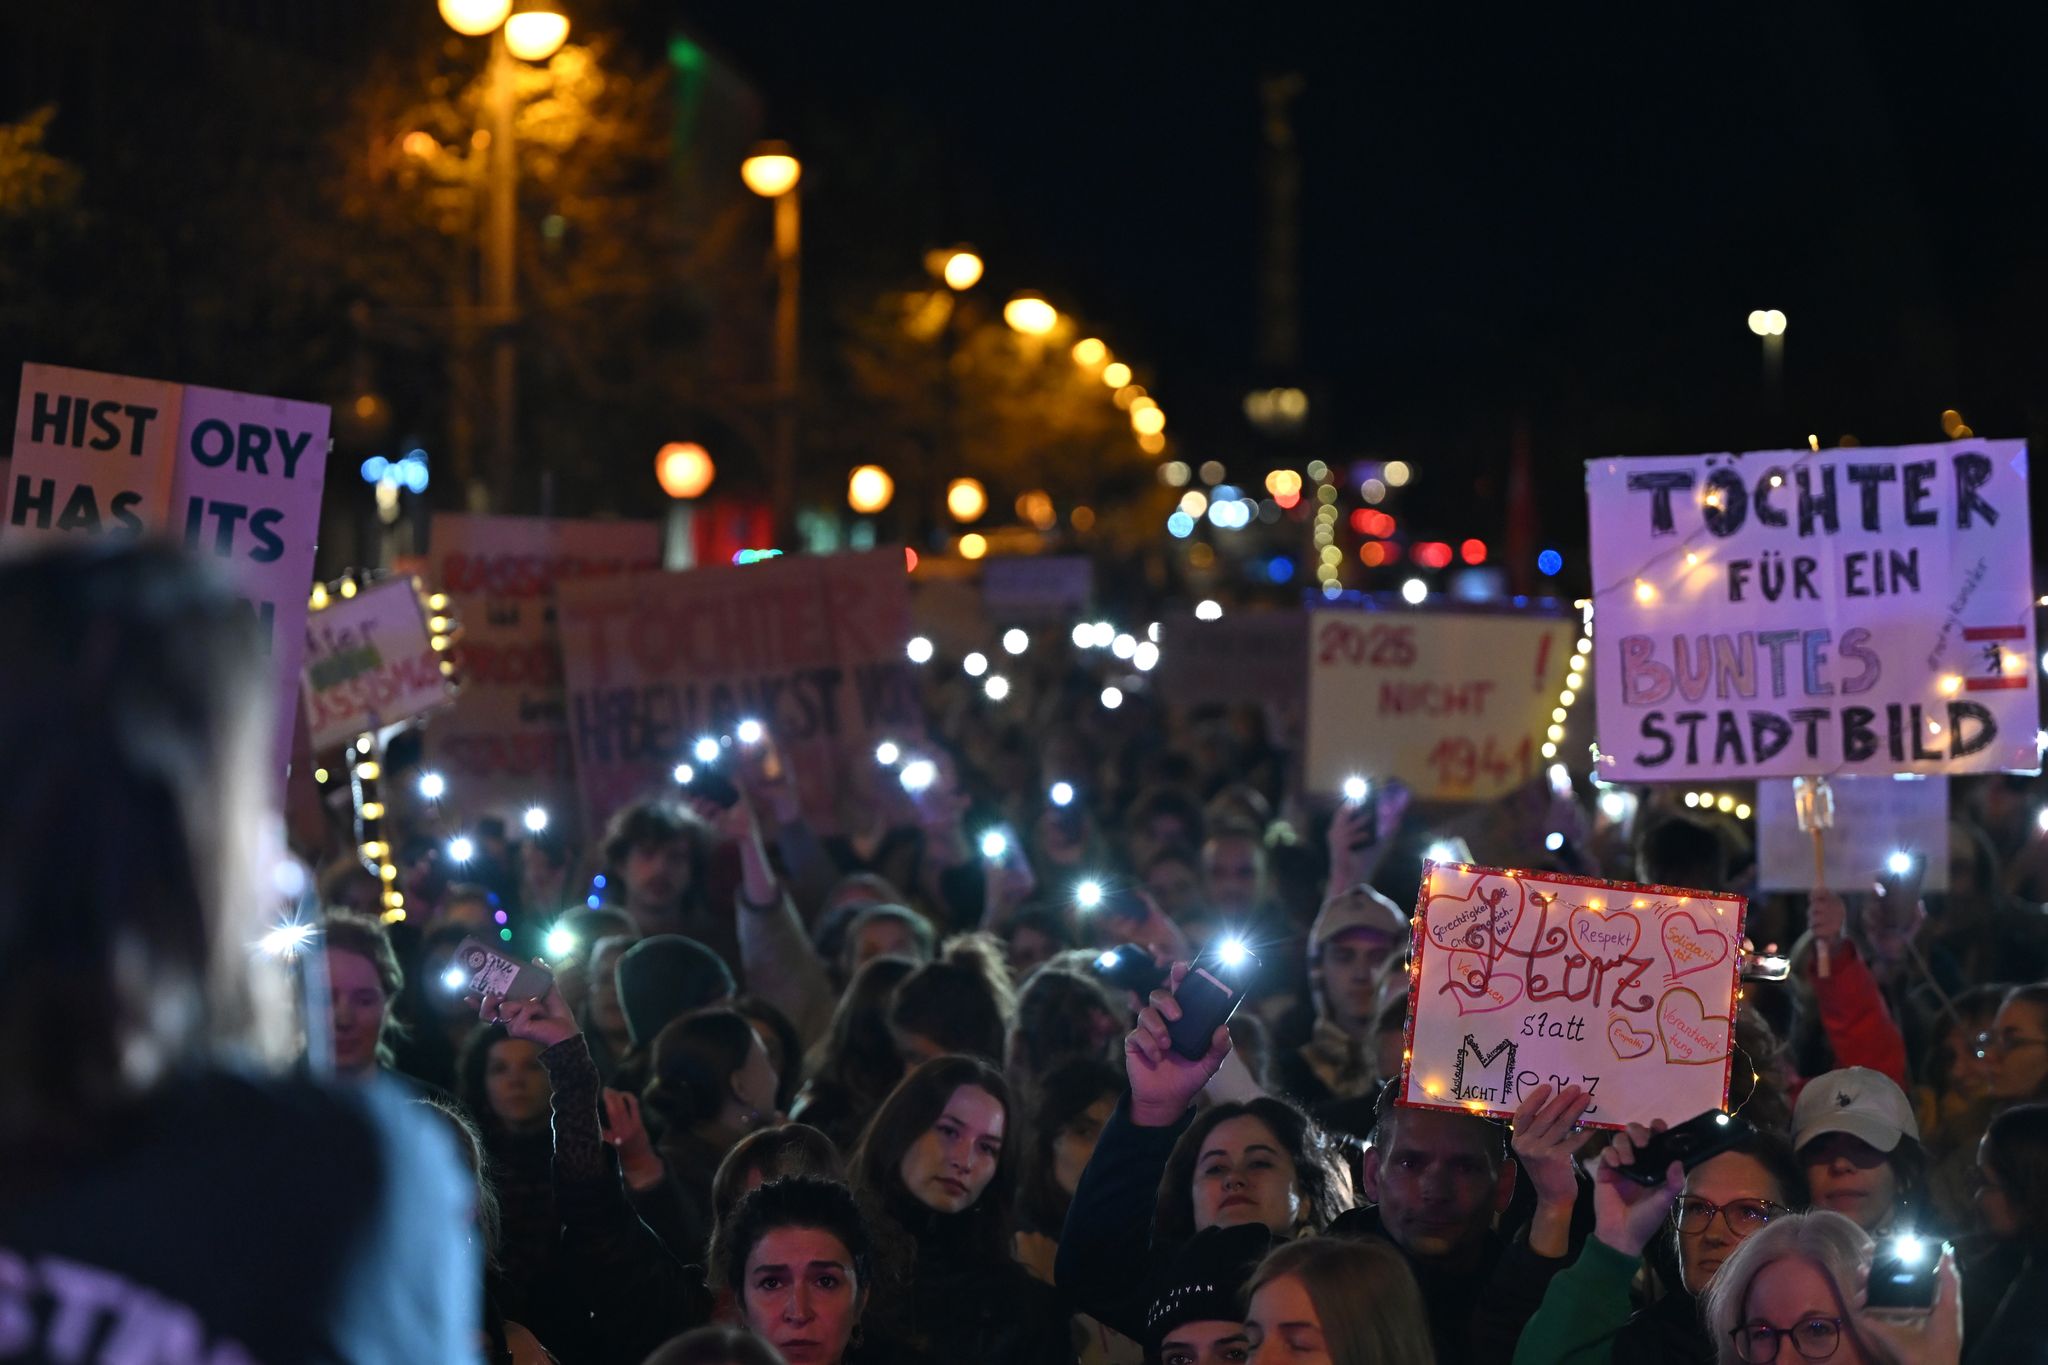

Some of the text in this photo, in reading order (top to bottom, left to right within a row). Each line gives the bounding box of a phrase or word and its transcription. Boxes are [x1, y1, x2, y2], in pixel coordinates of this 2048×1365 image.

[31, 392, 313, 480] HIST ORY
[1627, 452, 1998, 537] TÖCHTER
[183, 496, 285, 563] ITS
[1728, 547, 1920, 602] FÜR EIN
[1619, 627, 1882, 706] BUNTES
[1634, 701, 1998, 769] STADTBILD
[1432, 903, 1494, 943] Gerechtigkei
[1439, 886, 1655, 1013] Herz
[1578, 919, 1632, 952] Respekt
[1170, 1284, 1214, 1297] JIYAN
